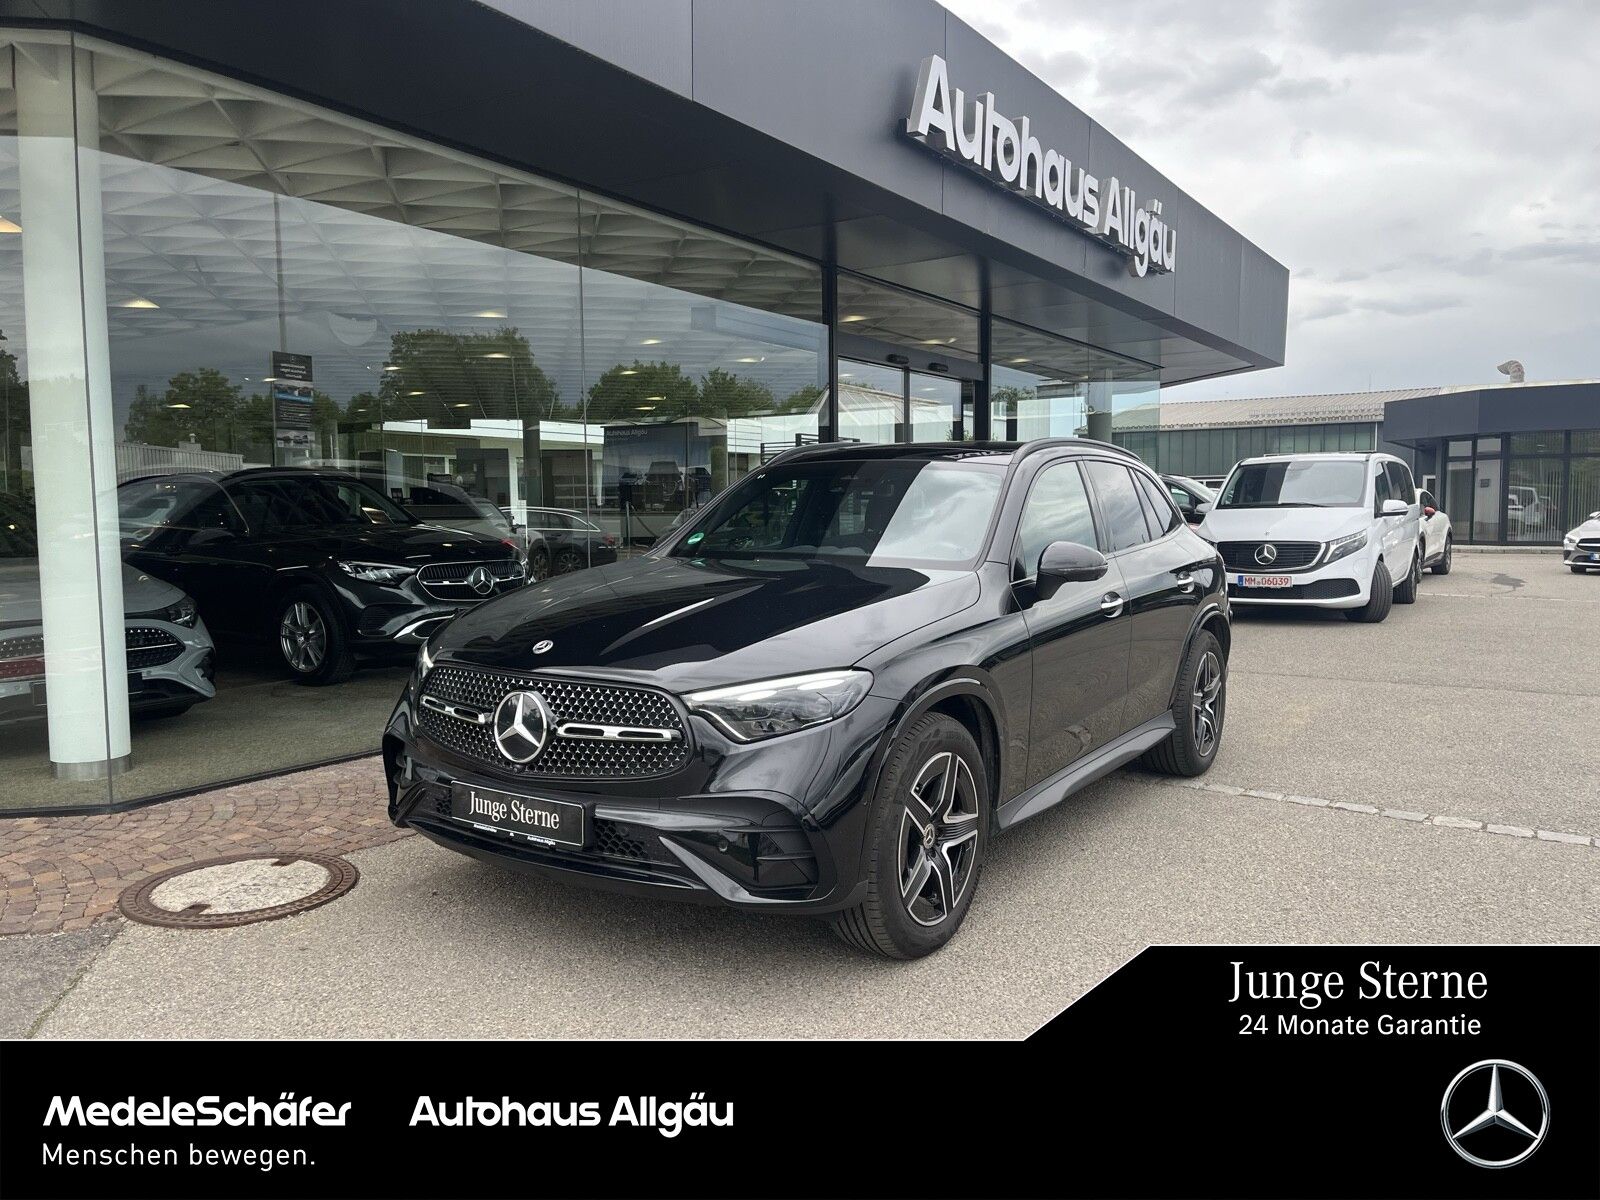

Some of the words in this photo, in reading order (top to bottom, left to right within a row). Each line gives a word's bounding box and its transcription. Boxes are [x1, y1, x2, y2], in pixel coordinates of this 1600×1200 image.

[908, 54, 1099, 229] Autohaus
[1100, 176, 1177, 278] Allgäu
[1244, 577, 1256, 585] MM
[1261, 577, 1289, 586] 06039
[469, 791, 507, 822] Junge
[510, 800, 560, 829] Sterne
